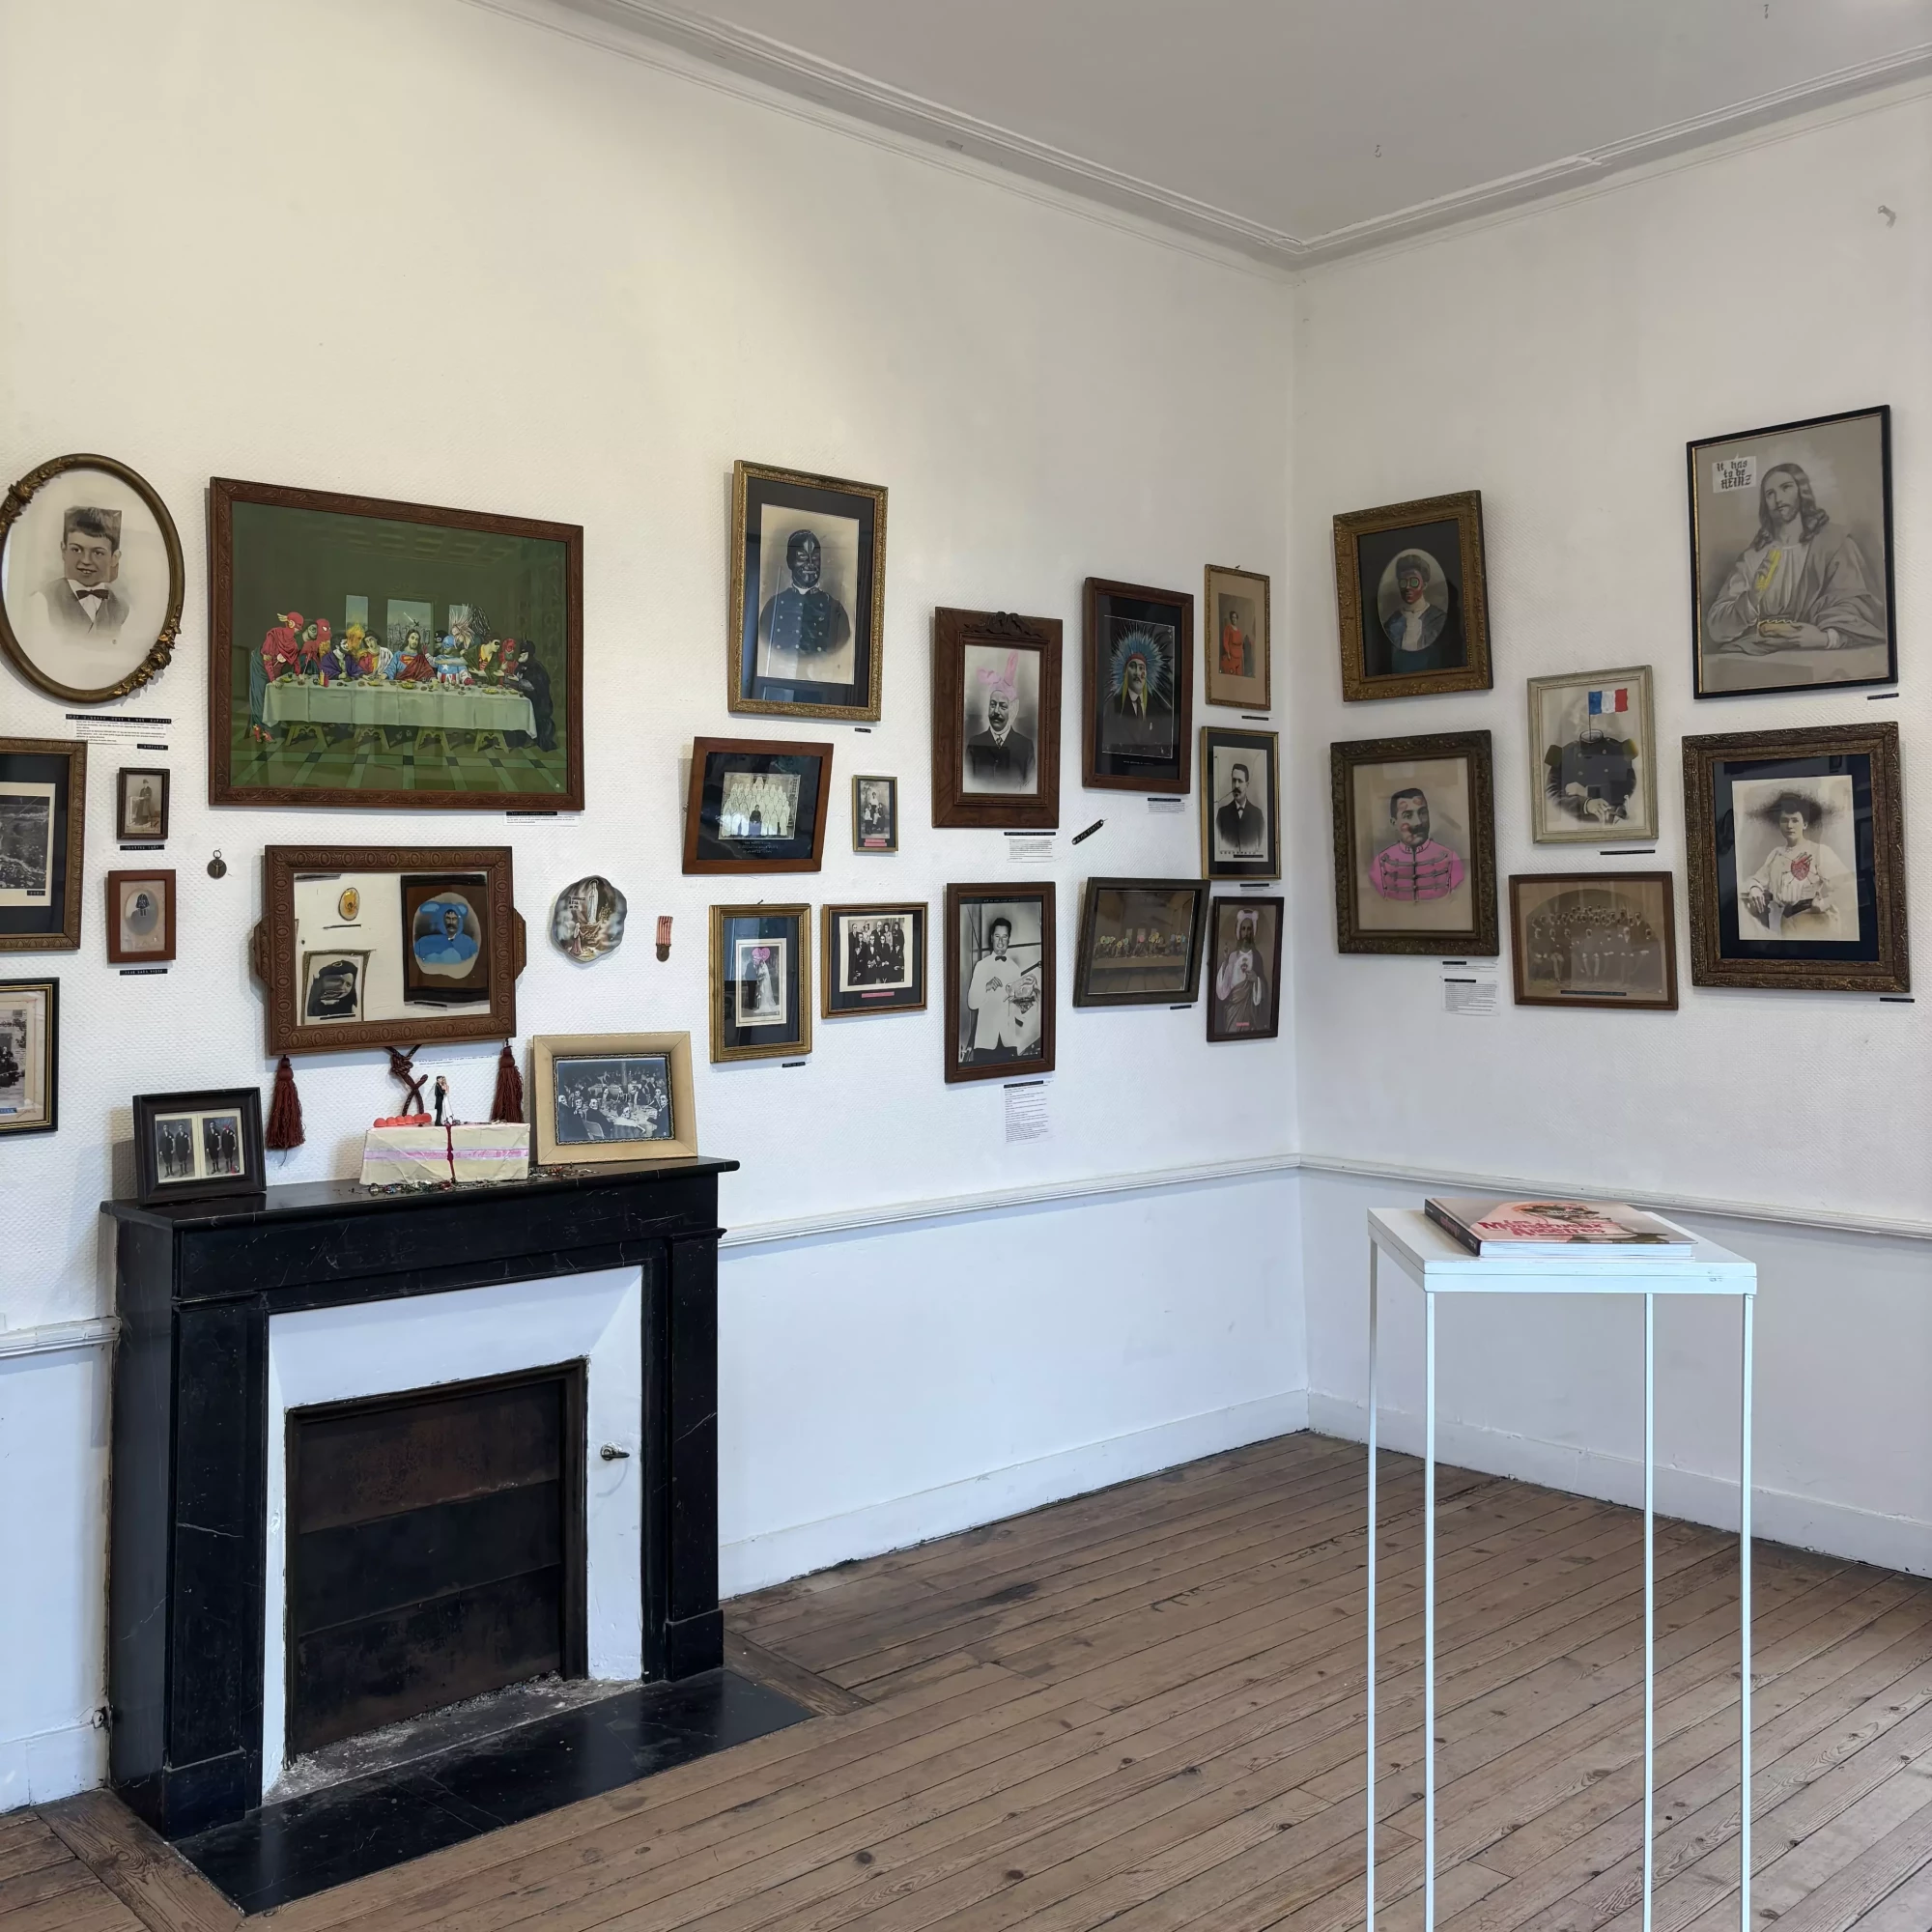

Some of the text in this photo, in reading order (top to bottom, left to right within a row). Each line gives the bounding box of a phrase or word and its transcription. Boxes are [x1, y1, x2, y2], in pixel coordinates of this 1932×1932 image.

[1731, 460, 1747, 469] has
[1723, 469, 1733, 478] to
[1720, 474, 1752, 489] HEINZ
